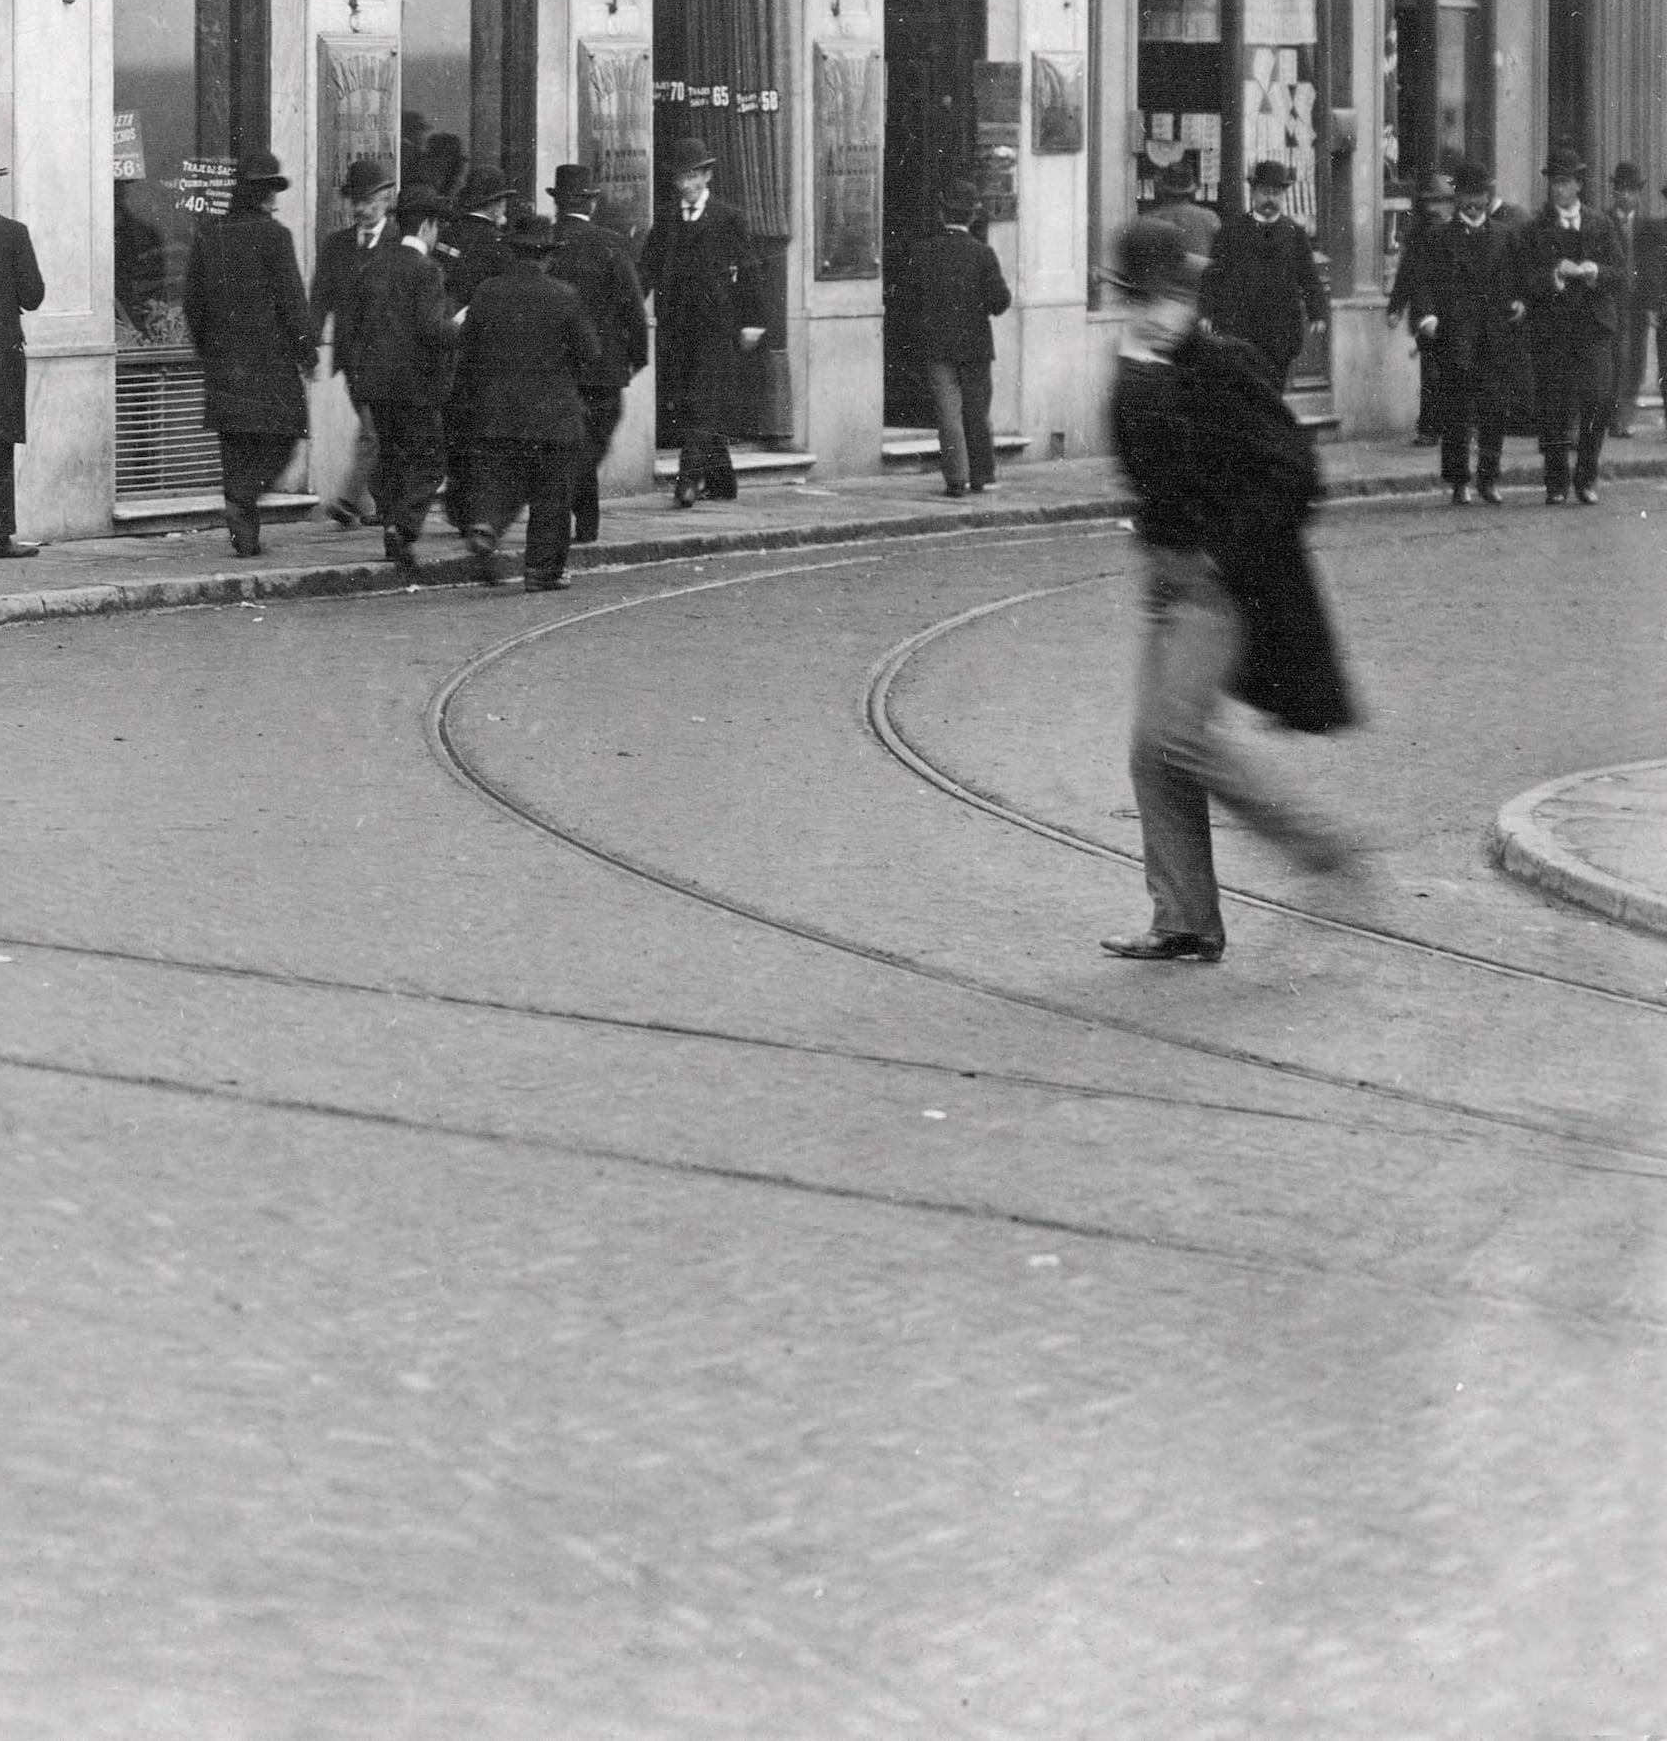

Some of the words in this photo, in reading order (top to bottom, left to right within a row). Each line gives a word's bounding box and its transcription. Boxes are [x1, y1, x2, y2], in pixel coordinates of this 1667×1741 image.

[671, 81, 684, 101] 70
[713, 86, 729, 106] 65
[761, 90, 778, 111] 58
[184, 195, 205, 212] 40
